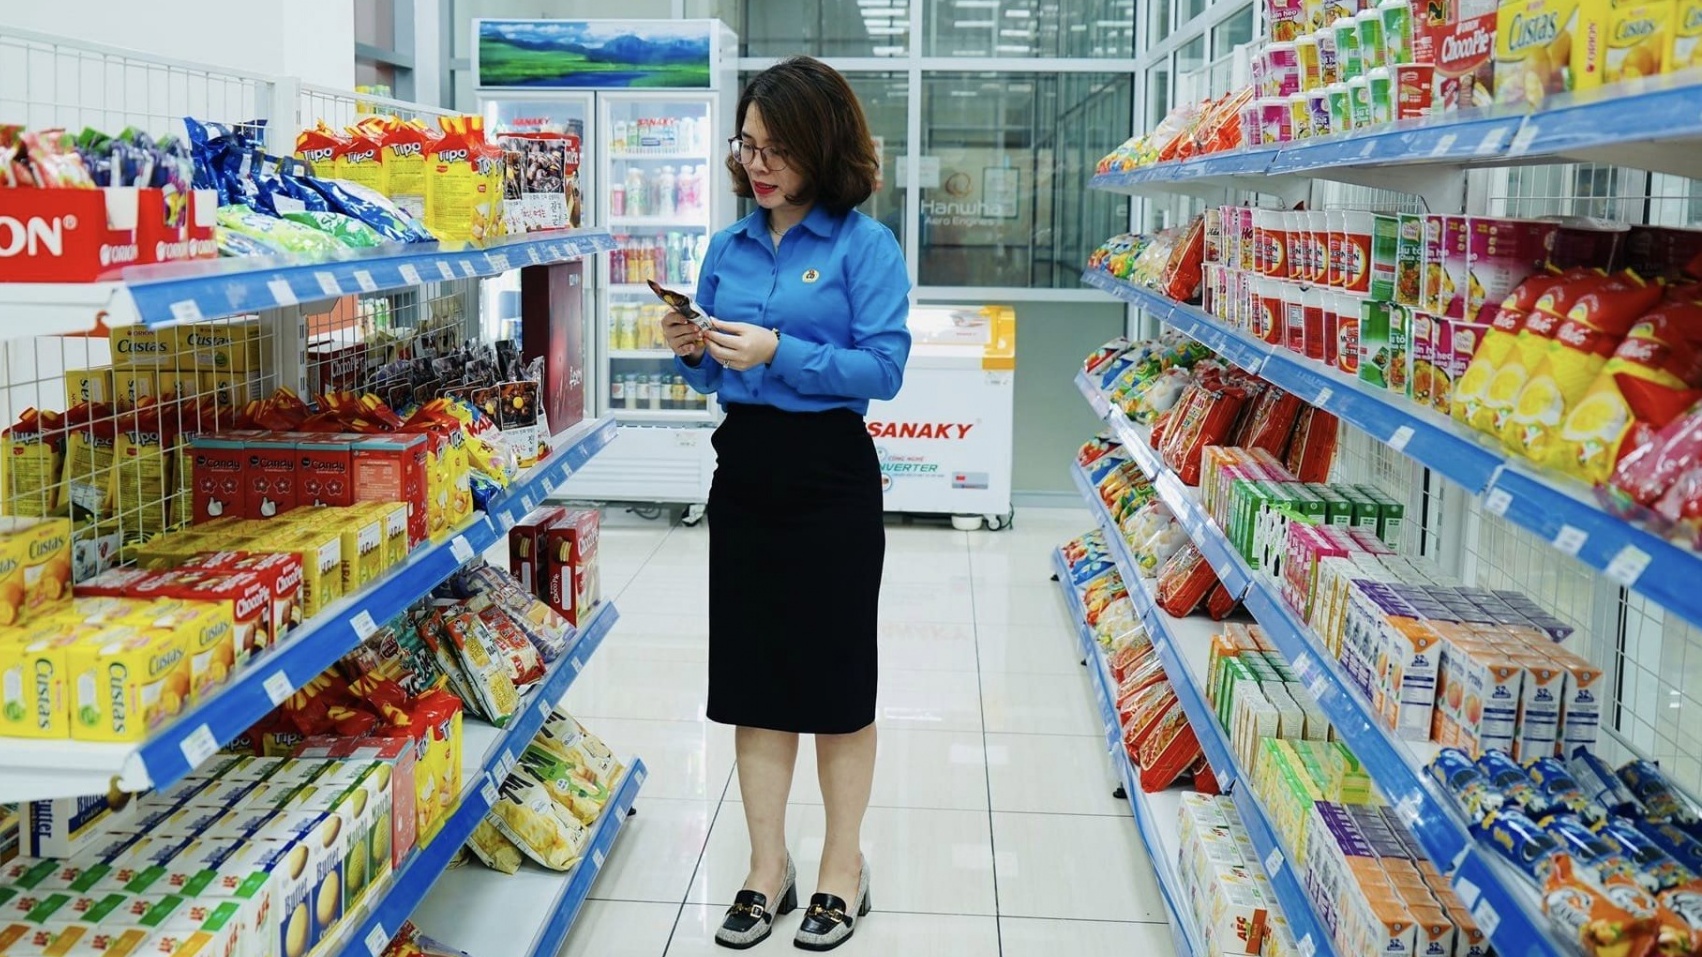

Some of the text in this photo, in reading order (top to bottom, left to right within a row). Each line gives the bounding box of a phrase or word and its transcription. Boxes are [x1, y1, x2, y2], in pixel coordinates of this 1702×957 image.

[1509, 11, 1559, 51] Custas
[302, 148, 333, 162] Tipo
[346, 149, 374, 163] Tipo
[390, 142, 422, 157] Tipo
[438, 148, 468, 162] Tipo
[921, 200, 1002, 216] Hanwha
[117, 339, 167, 353] Custas
[187, 333, 233, 346] Custas
[125, 431, 159, 447] Tipo
[867, 422, 973, 439] SANAKY
[880, 463, 938, 472] NVERTER
[29, 532, 66, 559] Custas
[199, 618, 230, 647] Custas
[149, 646, 184, 677] Custas
[35, 658, 53, 730] Custas
[109, 662, 127, 733] Custas
[317, 848, 339, 881] Butter
[285, 878, 308, 914] Butter
[1236, 916, 1247, 942] AFC
